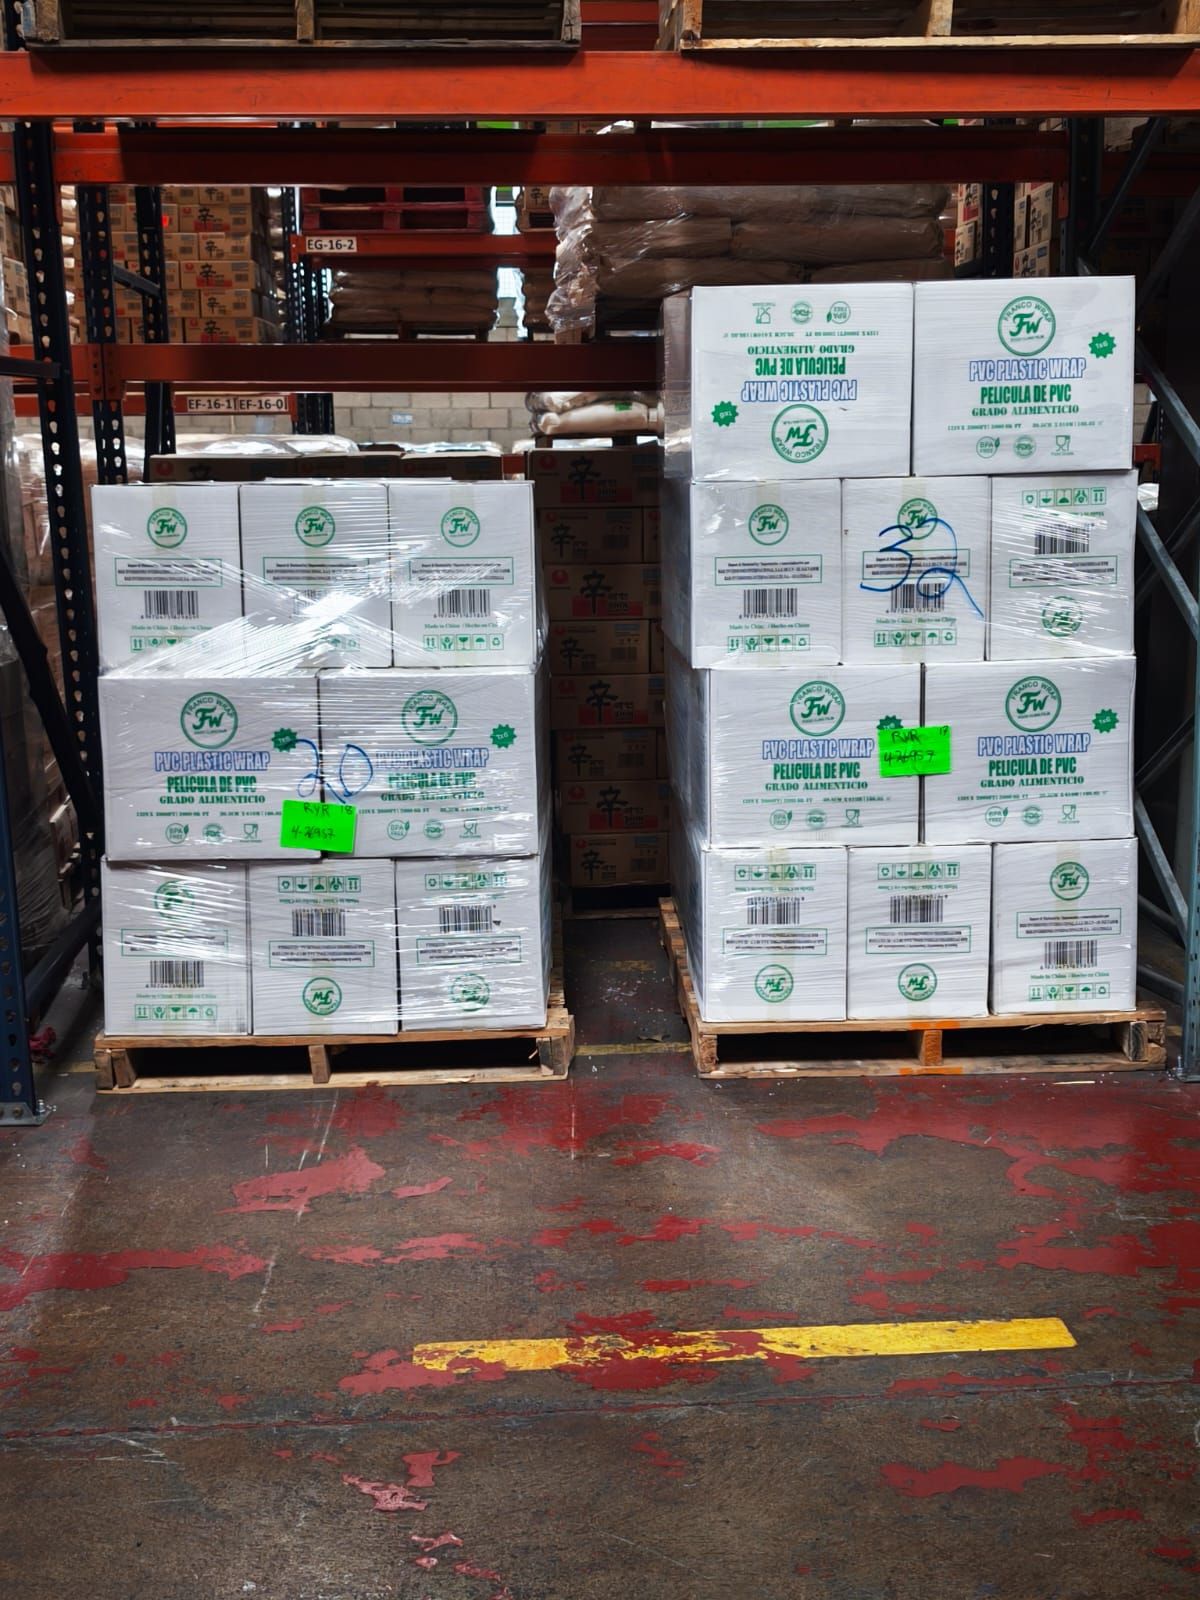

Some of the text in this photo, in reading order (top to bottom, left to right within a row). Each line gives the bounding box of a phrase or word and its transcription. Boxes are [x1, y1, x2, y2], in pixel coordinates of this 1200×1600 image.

[308, 240, 354, 250] EG-16-2
[1004, 302, 1052, 323] FRANCO WRAP
[748, 345, 855, 354] GRADO ALIMENTICIO
[756, 357, 846, 375] PELICULA DE PVC
[969, 358, 1086, 381] PVC PLASTIC WRAP
[742, 380, 857, 402] PVC PLASTIC WRAP
[980, 384, 1071, 404] PELICULA DE PVC
[188, 399, 232, 410] EF-16-1
[240, 399, 283, 410] EF-16-0
[972, 405, 1079, 416] GRADO ALIMENTICIO
[776, 437, 823, 458] FRANCO WRAP
[797, 685, 841, 706] FRANCO WRAP
[1011, 681, 1058, 700] FRANCO WRAP
[186, 697, 234, 718] FRANCO WRAP
[763, 739, 875, 760] PVC PLASTIC WRAP
[978, 733, 1091, 756] PVC PLASTIC WRAP
[155, 751, 270, 771] PVC PLASTIC WRAP
[989, 757, 1076, 776] PELICULA DE PVC
[774, 763, 860, 780] PELICULA DE PVC
[167, 776, 257, 793] PELICULA DE PVC
[765, 781, 868, 791] GRADO ALIMENTICIO
[981, 776, 1084, 788] GRADO ALIMENTICIO
[160, 795, 265, 804] GRADO ALIMENTICIO
